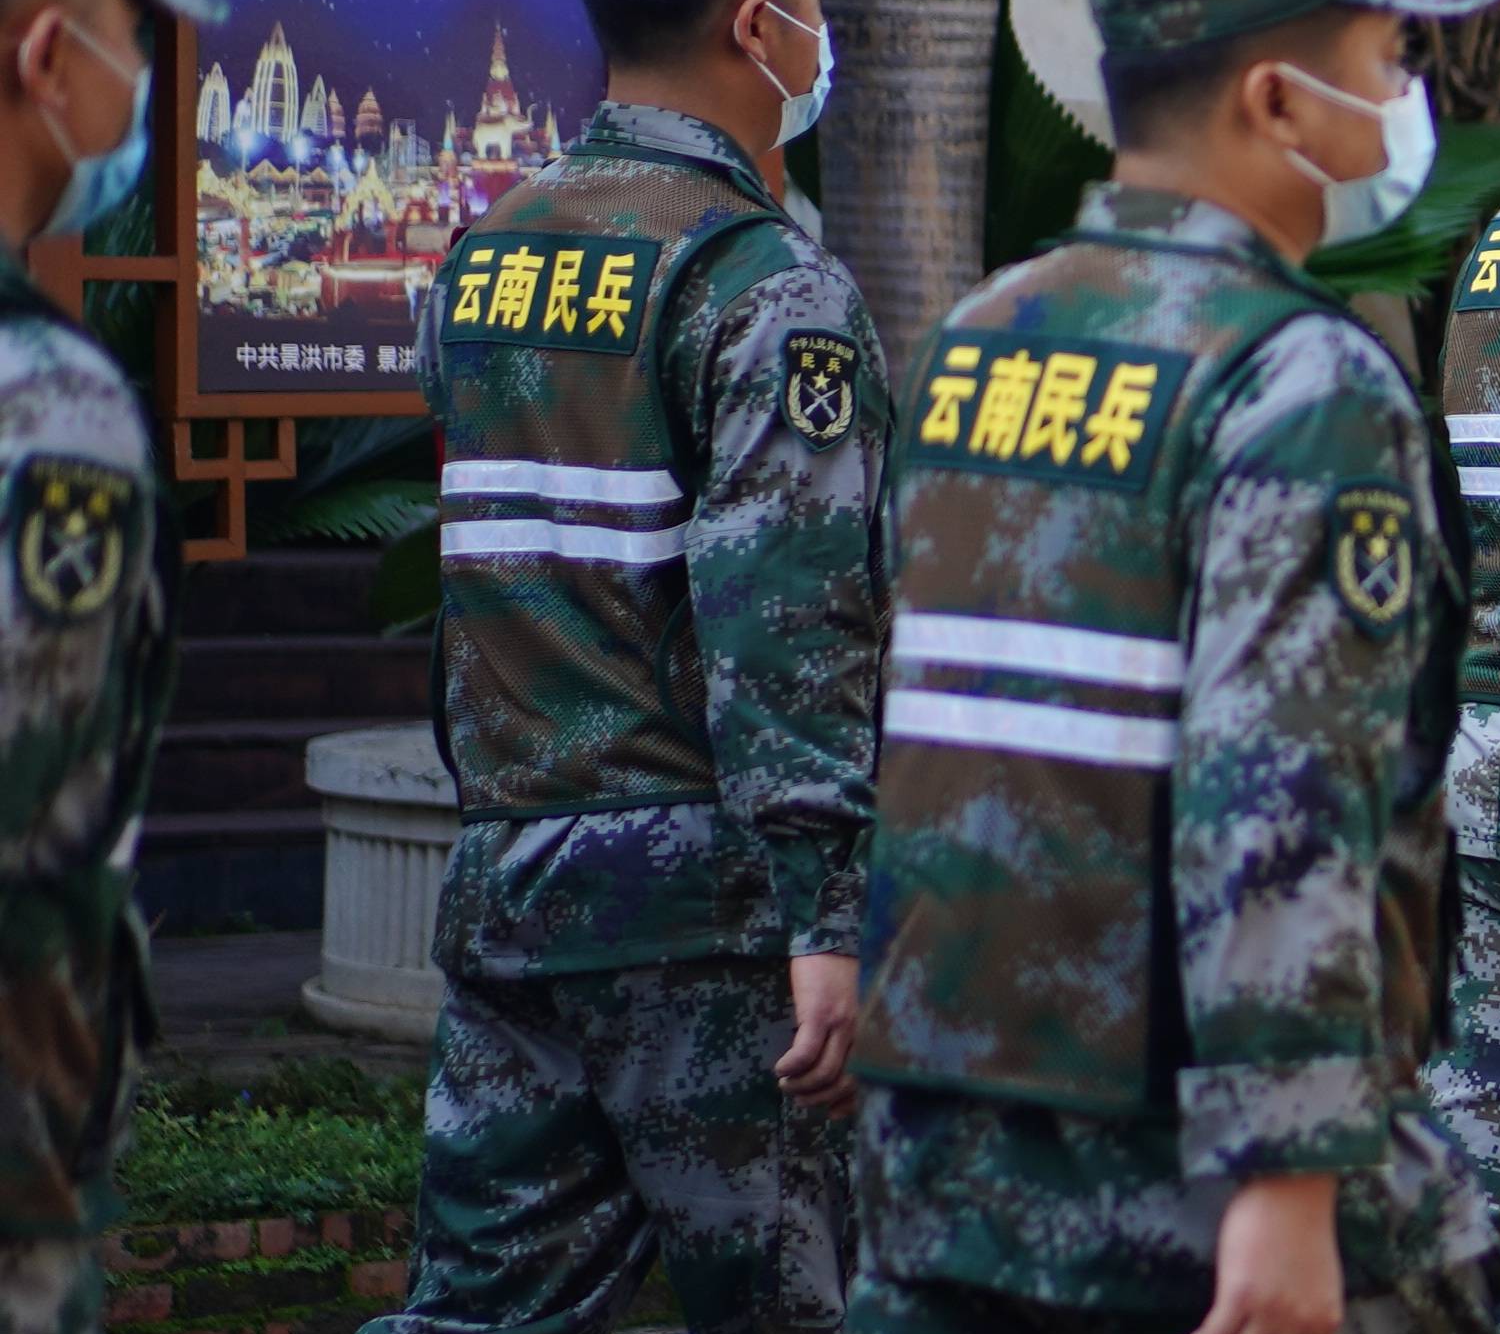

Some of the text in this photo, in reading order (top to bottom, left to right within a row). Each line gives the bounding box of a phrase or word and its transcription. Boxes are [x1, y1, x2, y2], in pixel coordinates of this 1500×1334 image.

[452, 245, 637, 339] 云南民兵
[236, 342, 366, 373] 中共景洪市委
[919, 344, 1158, 474] 云南民兵
